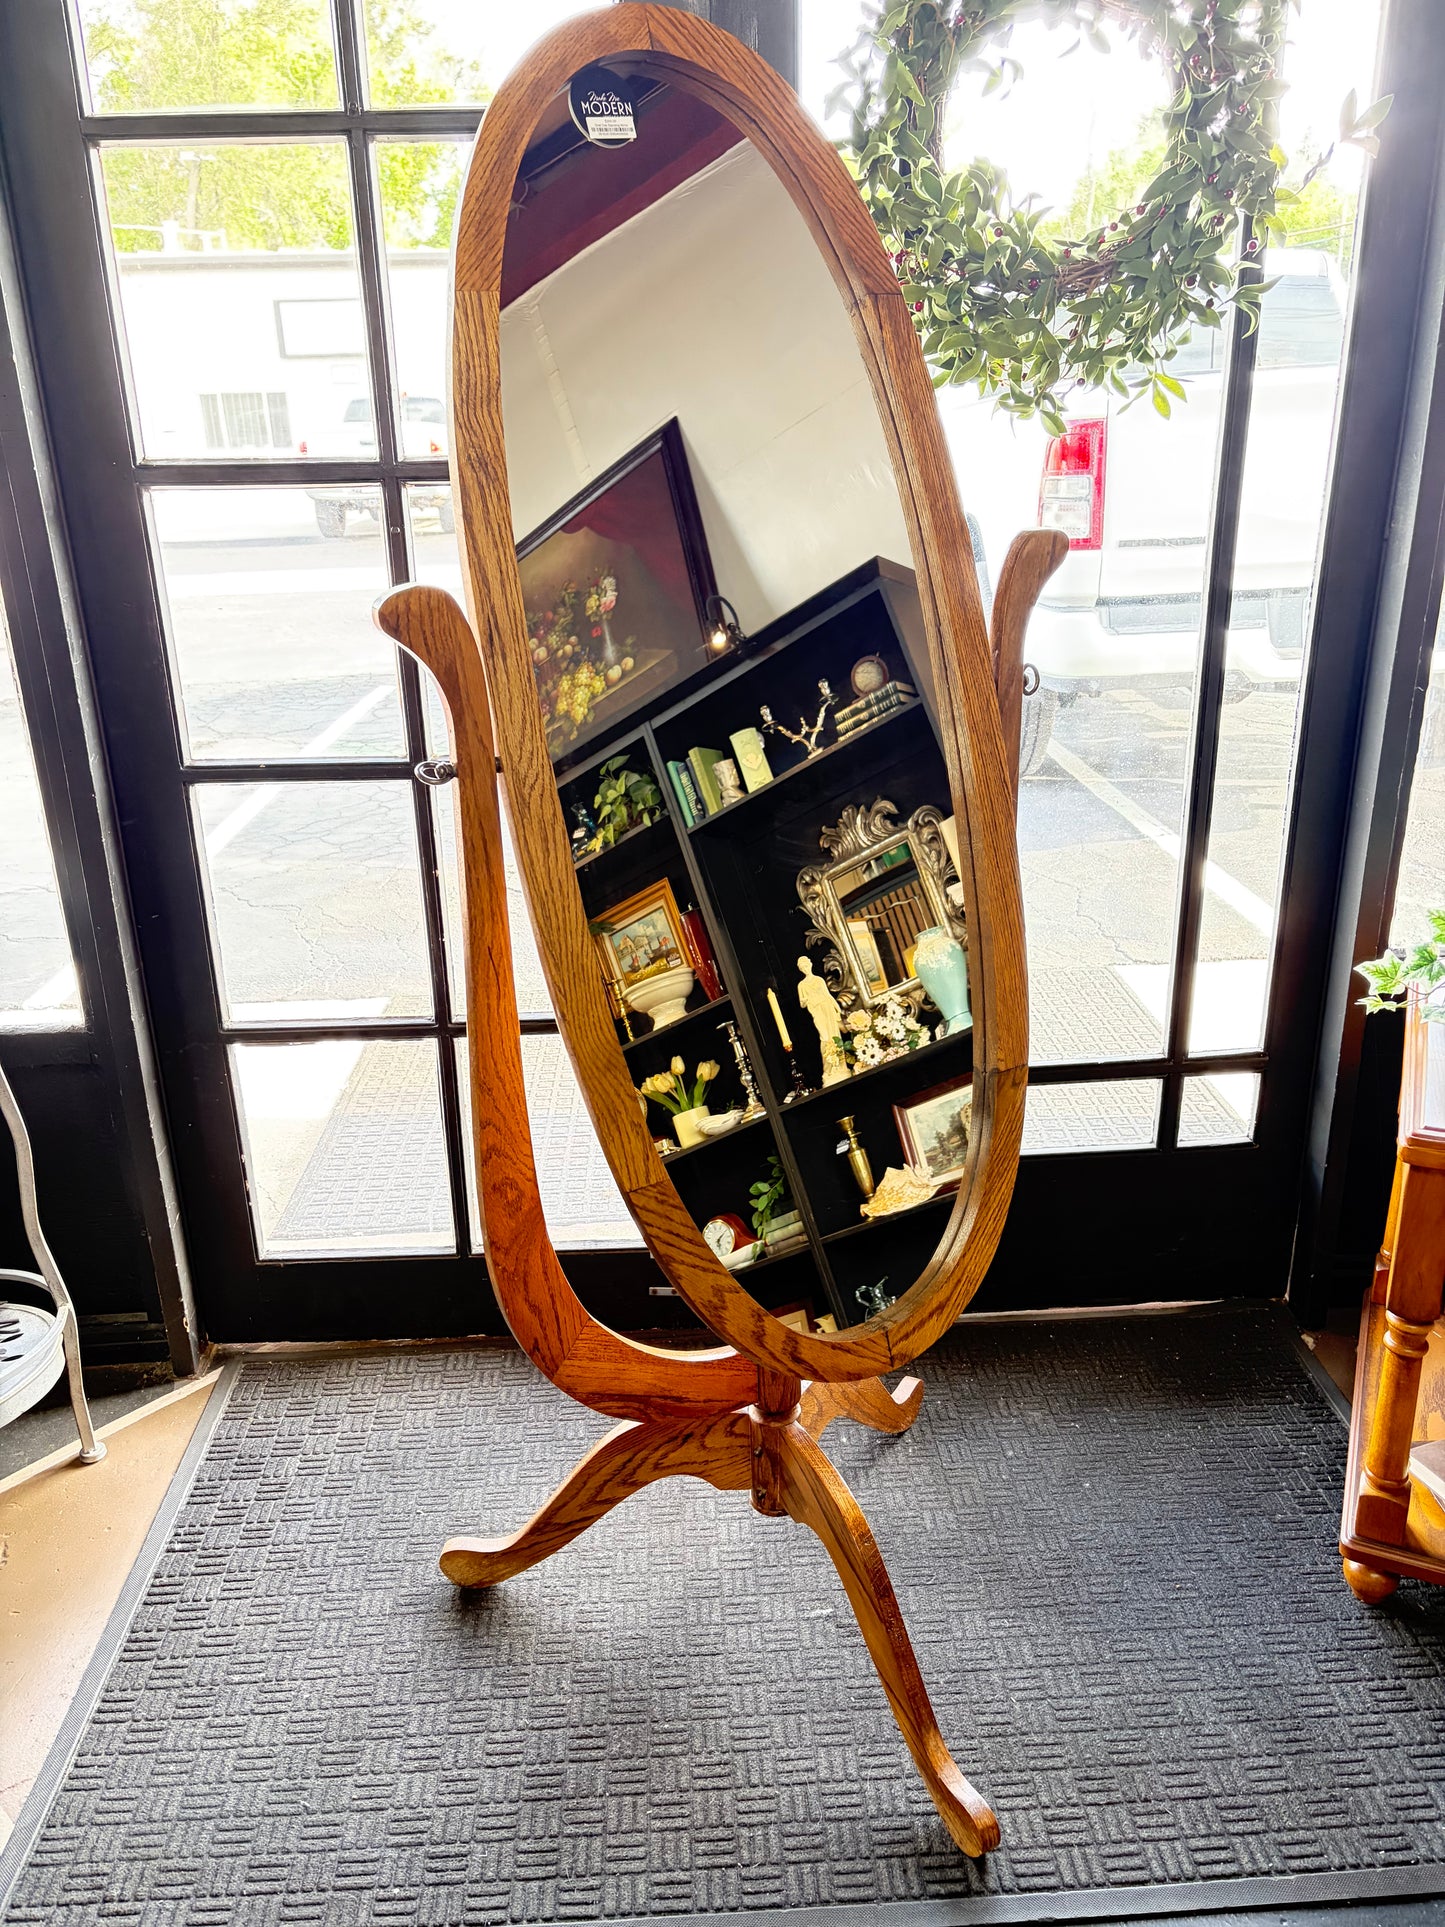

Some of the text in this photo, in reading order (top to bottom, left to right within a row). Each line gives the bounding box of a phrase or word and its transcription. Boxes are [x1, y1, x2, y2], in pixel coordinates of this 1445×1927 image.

[587, 91, 620, 101] Make Me
[581, 101, 633, 115] MODERN
